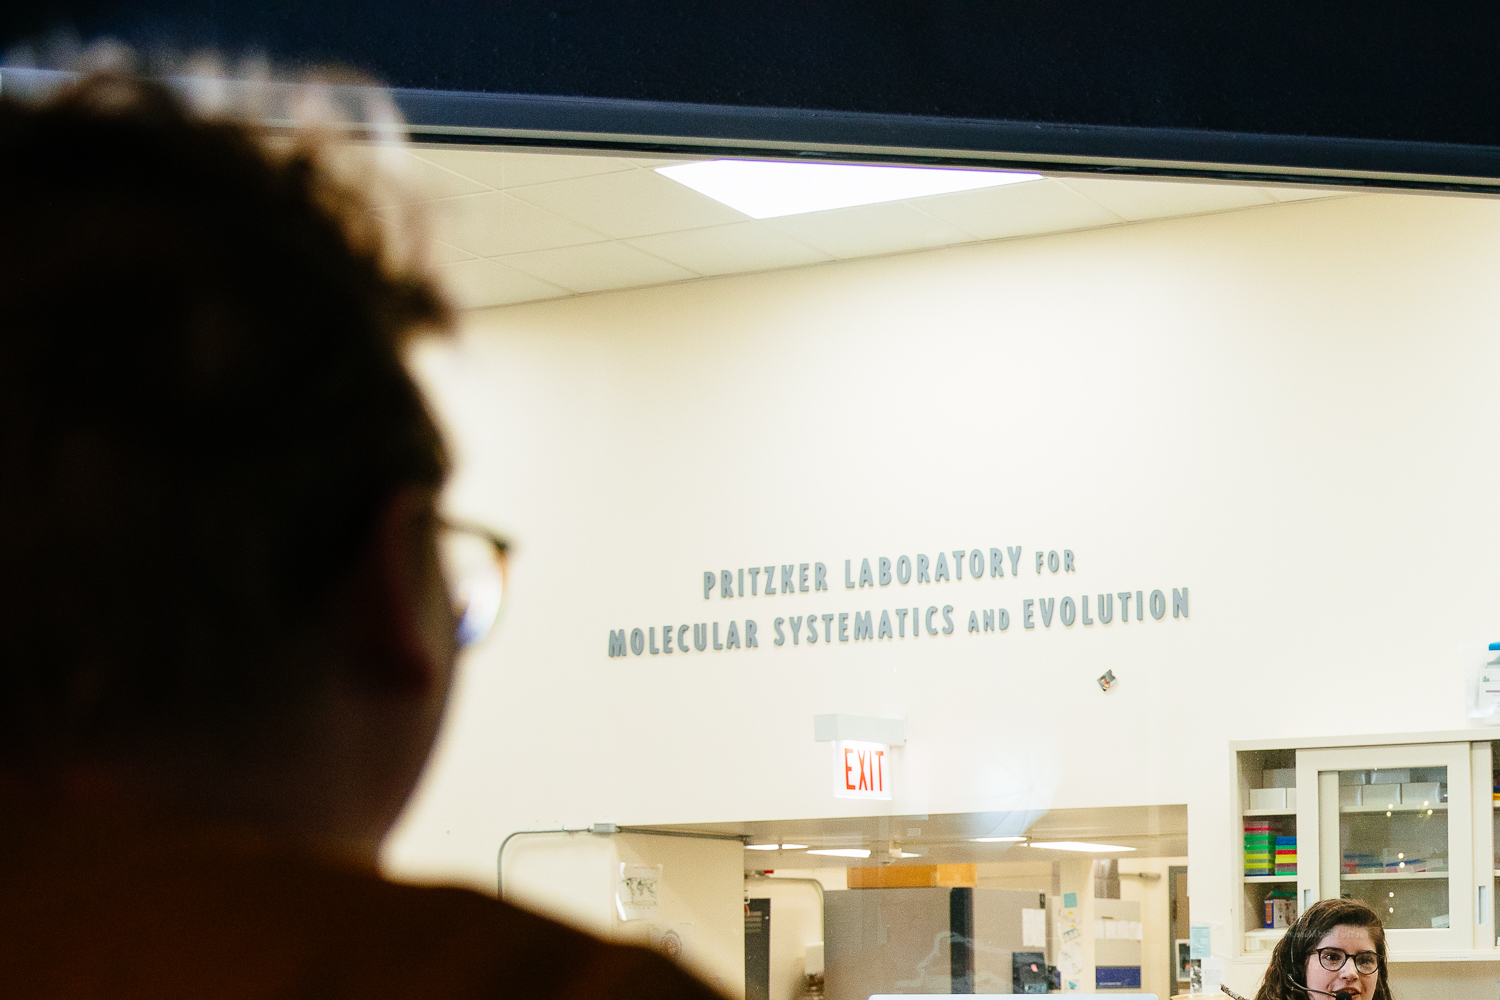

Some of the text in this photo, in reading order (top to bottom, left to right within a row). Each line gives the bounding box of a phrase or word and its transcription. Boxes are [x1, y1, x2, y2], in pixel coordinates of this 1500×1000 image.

[703, 546, 1075, 600] PRITZKER LABORATORY FOR
[608, 588, 1188, 657] MOLECULAR SYSTEMATICS AND EVOLUTION
[844, 748, 884, 792] EXIT
